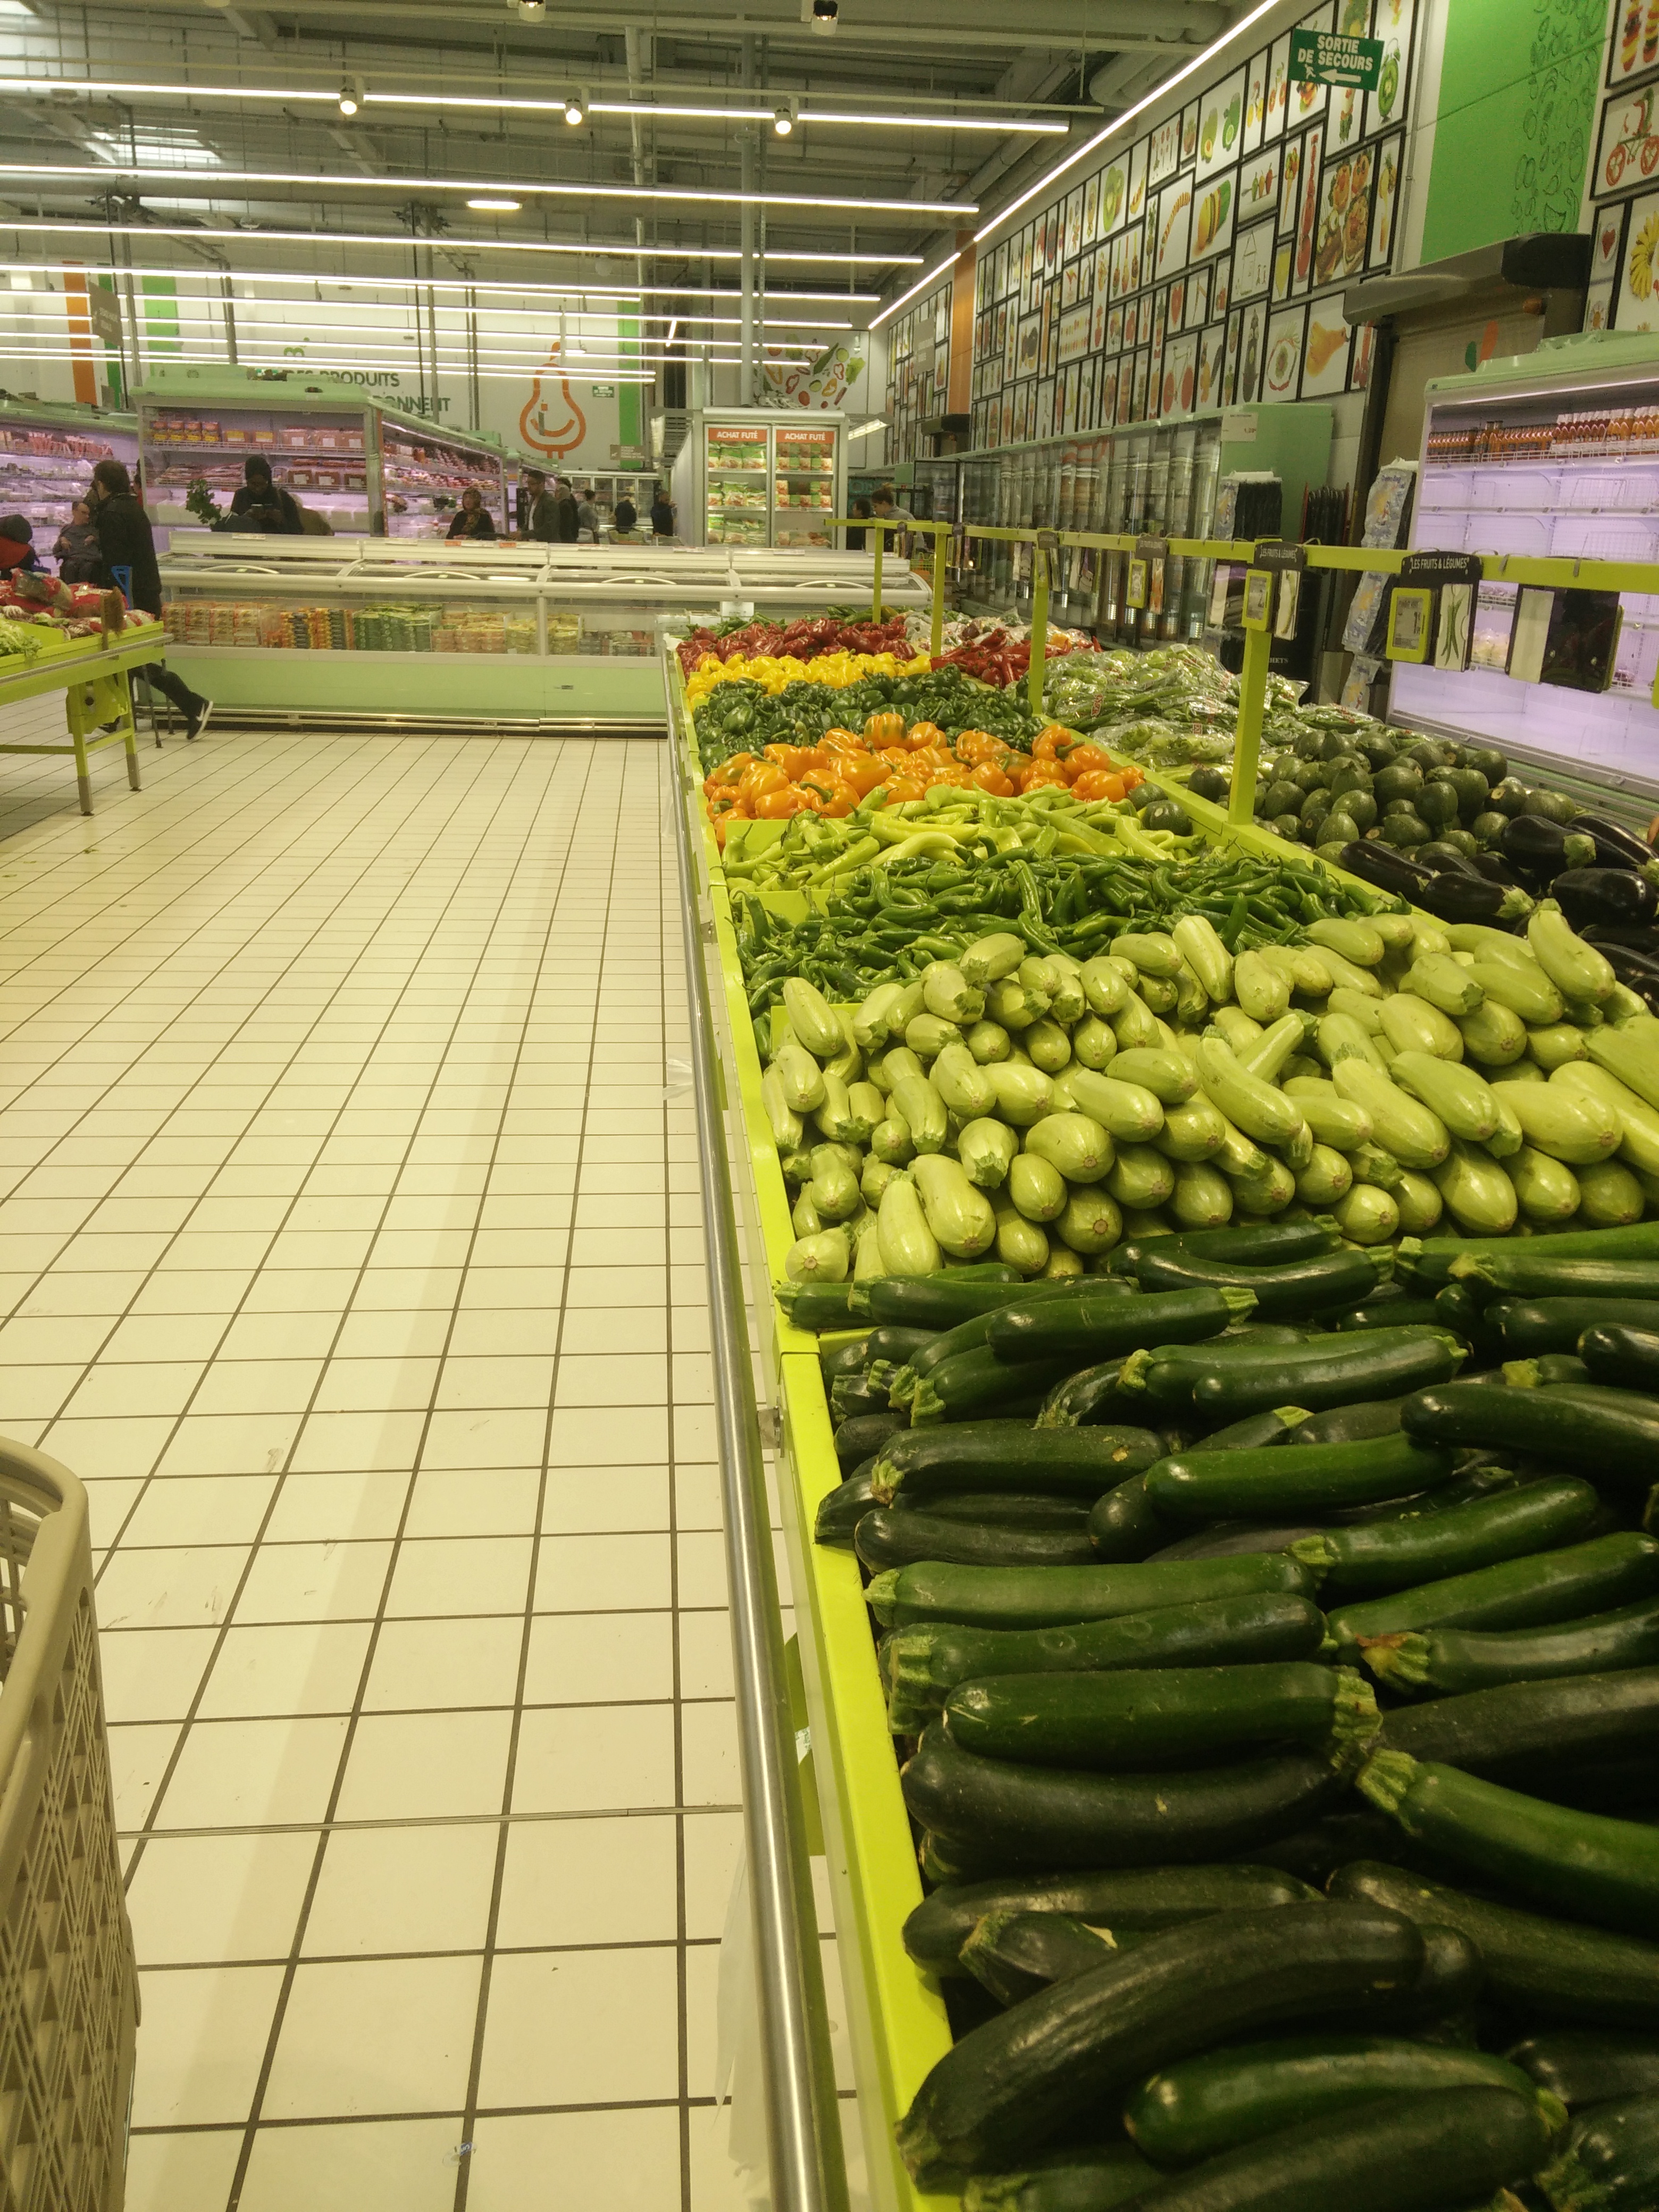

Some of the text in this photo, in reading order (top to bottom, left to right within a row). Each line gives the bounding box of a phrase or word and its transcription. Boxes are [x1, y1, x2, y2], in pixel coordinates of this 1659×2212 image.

[1317, 35, 1360, 53] SORTIE
[1297, 48, 1374, 71] DE SECOURS
[320, 371, 400, 387] ODUITS
[373, 395, 451, 412] NNET
[741, 430, 758, 439] FUTÉ
[809, 432, 825, 440] FUTÉ
[1411, 555, 1468, 569] LES FRUITS & LÉGUMES
